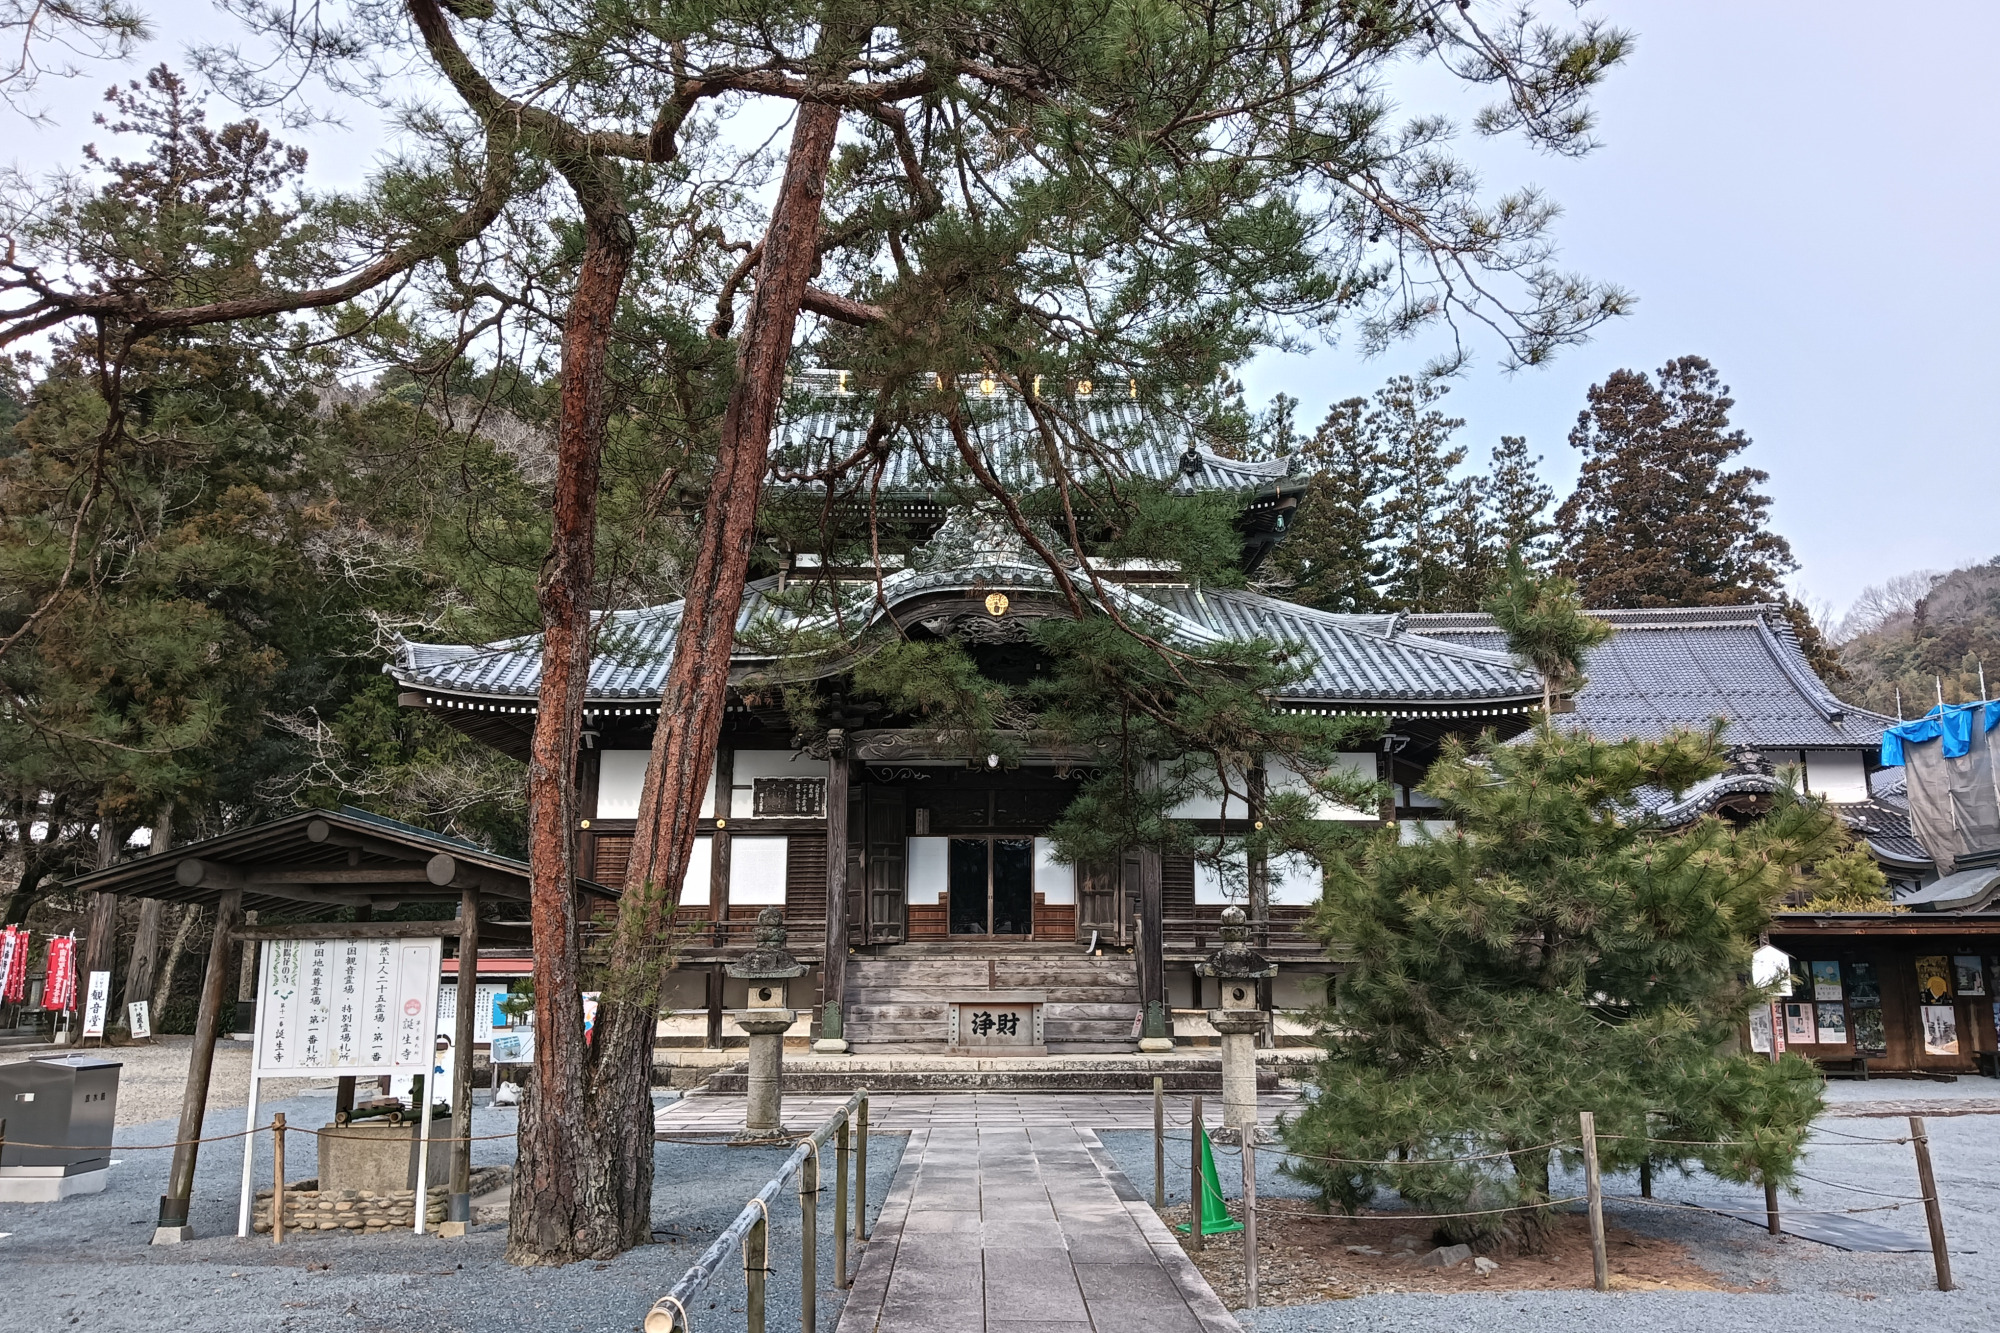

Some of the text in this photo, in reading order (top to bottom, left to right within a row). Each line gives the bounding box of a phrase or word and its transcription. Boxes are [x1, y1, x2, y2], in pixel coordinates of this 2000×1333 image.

[89, 989, 105, 1027] 観音堂
[971, 1010, 1020, 1037] 浄財
[274, 1029, 285, 1063] 誕生寺
[401, 1018, 414, 1060] 誕生寺
